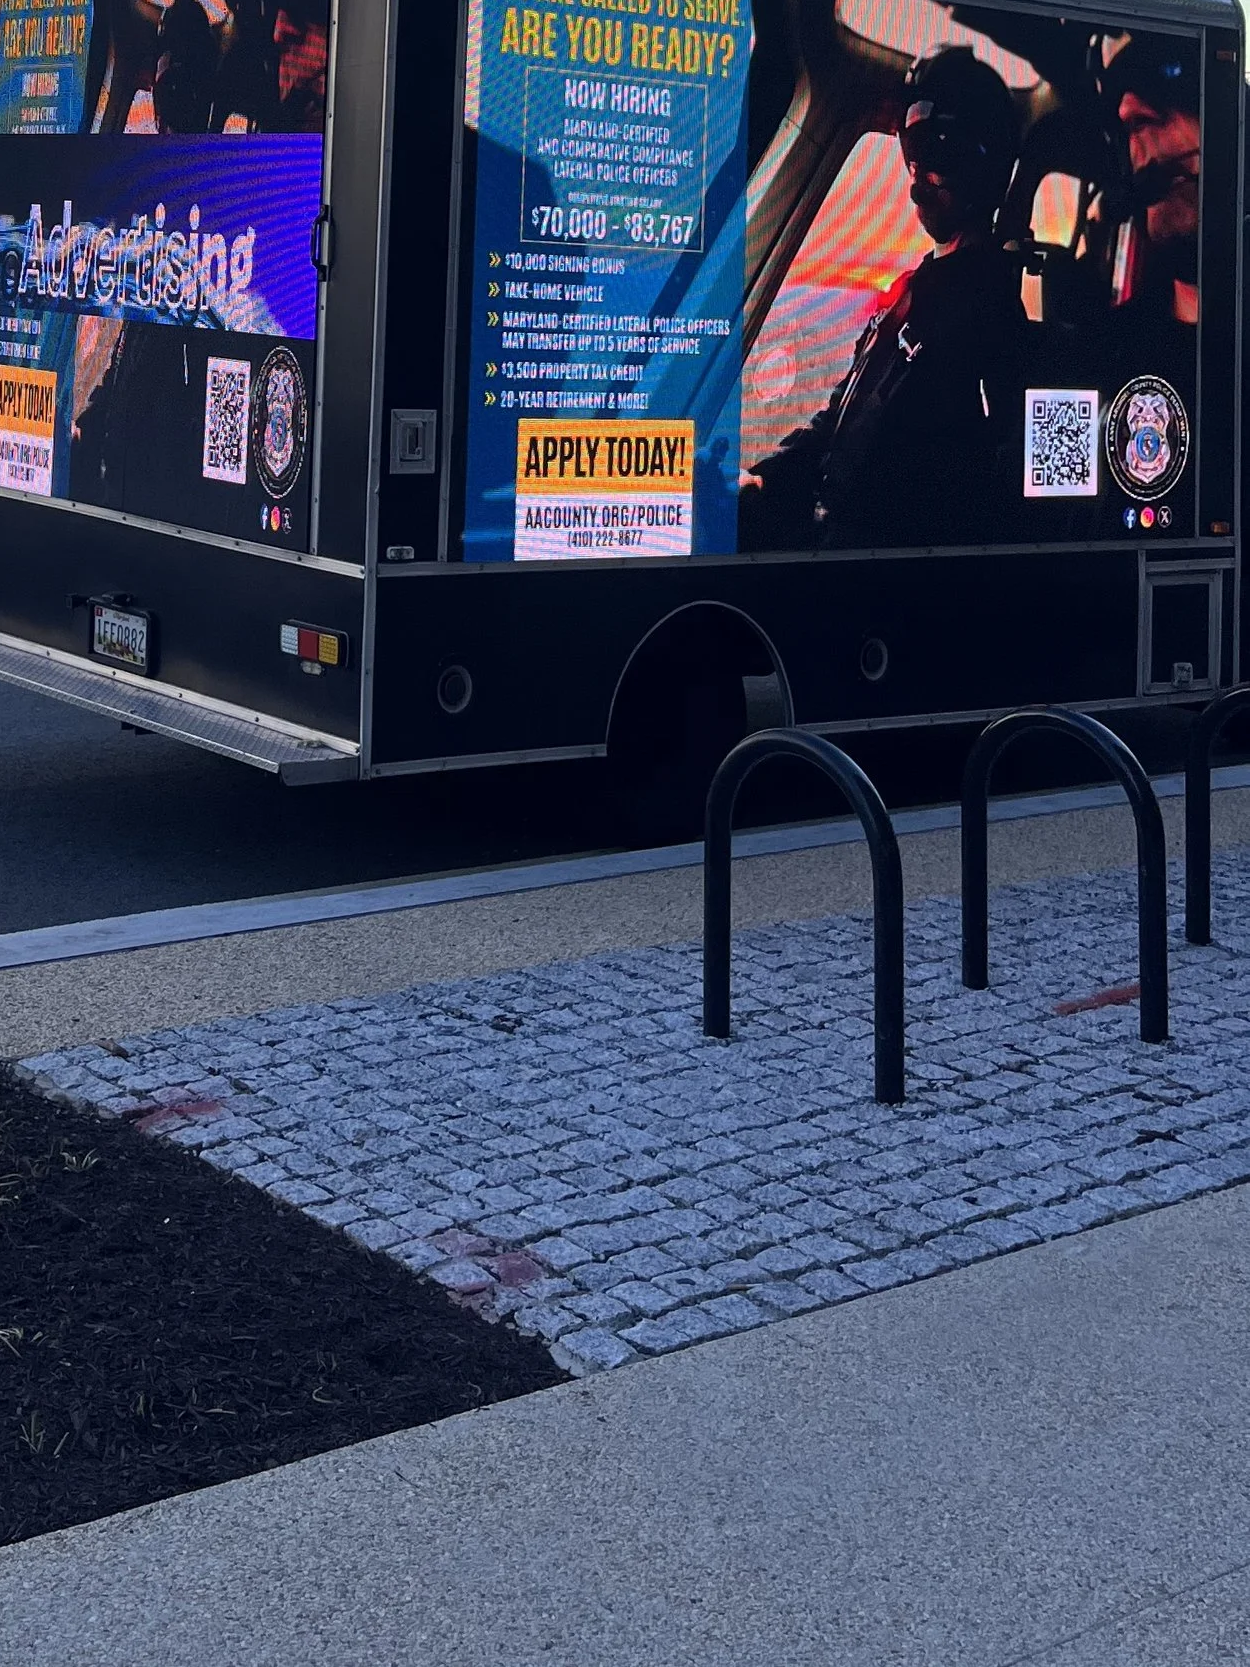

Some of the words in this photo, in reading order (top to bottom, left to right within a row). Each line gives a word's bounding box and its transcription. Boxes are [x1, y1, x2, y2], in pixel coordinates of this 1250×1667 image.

[501, 7, 557, 59] ARE
[565, 13, 622, 65] YOU
[631, 22, 735, 78] READY?
[564, 79, 606, 110] NOW
[610, 83, 671, 117] HIRING
[537, 137, 559, 156] AND
[561, 139, 630, 162] COMPARATIVE
[633, 145, 694, 169] COMPLIANCE
[554, 159, 594, 180] LATERAL
[597, 163, 630, 183] POLICE
[633, 166, 678, 187] OFFICERS
[532, 206, 606, 241] $70,000
[623, 212, 694, 247] $83,767
[18, 200, 256, 310] Advertising
[505, 252, 546, 273] $10,000
[548, 254, 590, 274] SIGNING
[592, 257, 625, 275] BONUS
[504, 281, 562, 300] TAKE-HOME
[564, 284, 604, 302] VEHICLE
[613, 315, 652, 332] LATERAL
[653, 316, 686, 334] POLICE
[687, 318, 730, 335] OFFICERS
[502, 331, 525, 349] MAY
[527, 332, 576, 351] TRANSFER
[578, 334, 592, 351] UP
[594, 334, 605, 351] TO
[607, 335, 614, 352] 5
[616, 335, 646, 353] YEARS
[647, 336, 660, 353] OF
[661, 337, 700, 354] SERVICE
[502, 361, 537, 380] $3,500
[538, 362, 591, 380] PROPERTY
[591, 364, 608, 381] TAX
[610, 364, 644, 381] CREDIT
[22, 382, 53, 423] TODAY!
[500, 390, 544, 408] 20-YEAR
[545, 391, 606, 409] RETIREMENT
[608, 392, 616, 409] &
[617, 392, 649, 410] MORE!
[525, 436, 600, 478] APPLY
[605, 436, 686, 477] TODAY!
[525, 504, 683, 529] AACOUNTY.ORG/POLICE
[567, 530, 592, 548] (410)
[595, 530, 643, 547] 222-8677
